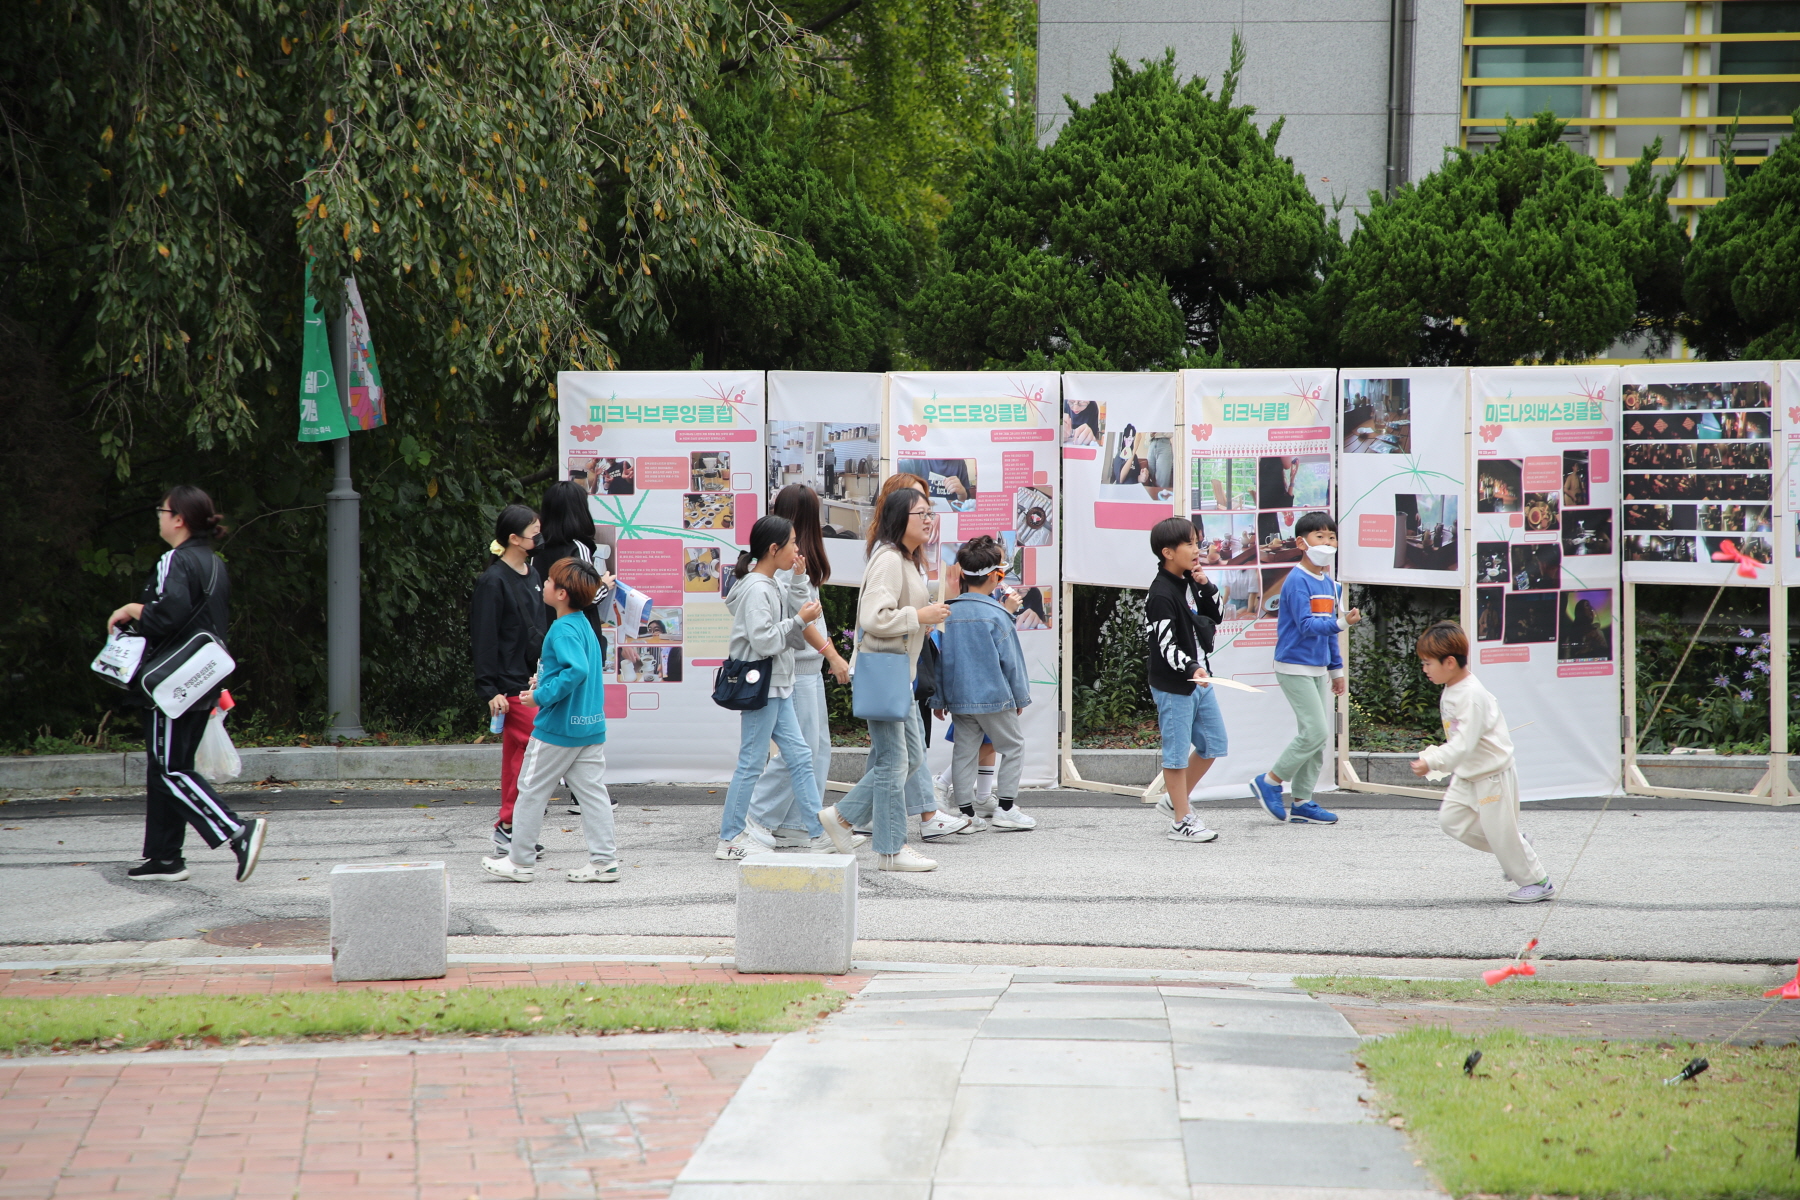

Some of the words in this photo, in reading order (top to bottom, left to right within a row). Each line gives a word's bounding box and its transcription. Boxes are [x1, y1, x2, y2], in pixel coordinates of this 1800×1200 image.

[589, 405, 733, 424] 피크닉브루잉클럽
[923, 404, 1028, 423] 우드드로잉클럽
[1223, 402, 1290, 422] 티크닉클럽
[1485, 401, 1603, 423] 미드나잇버스킹클럽
